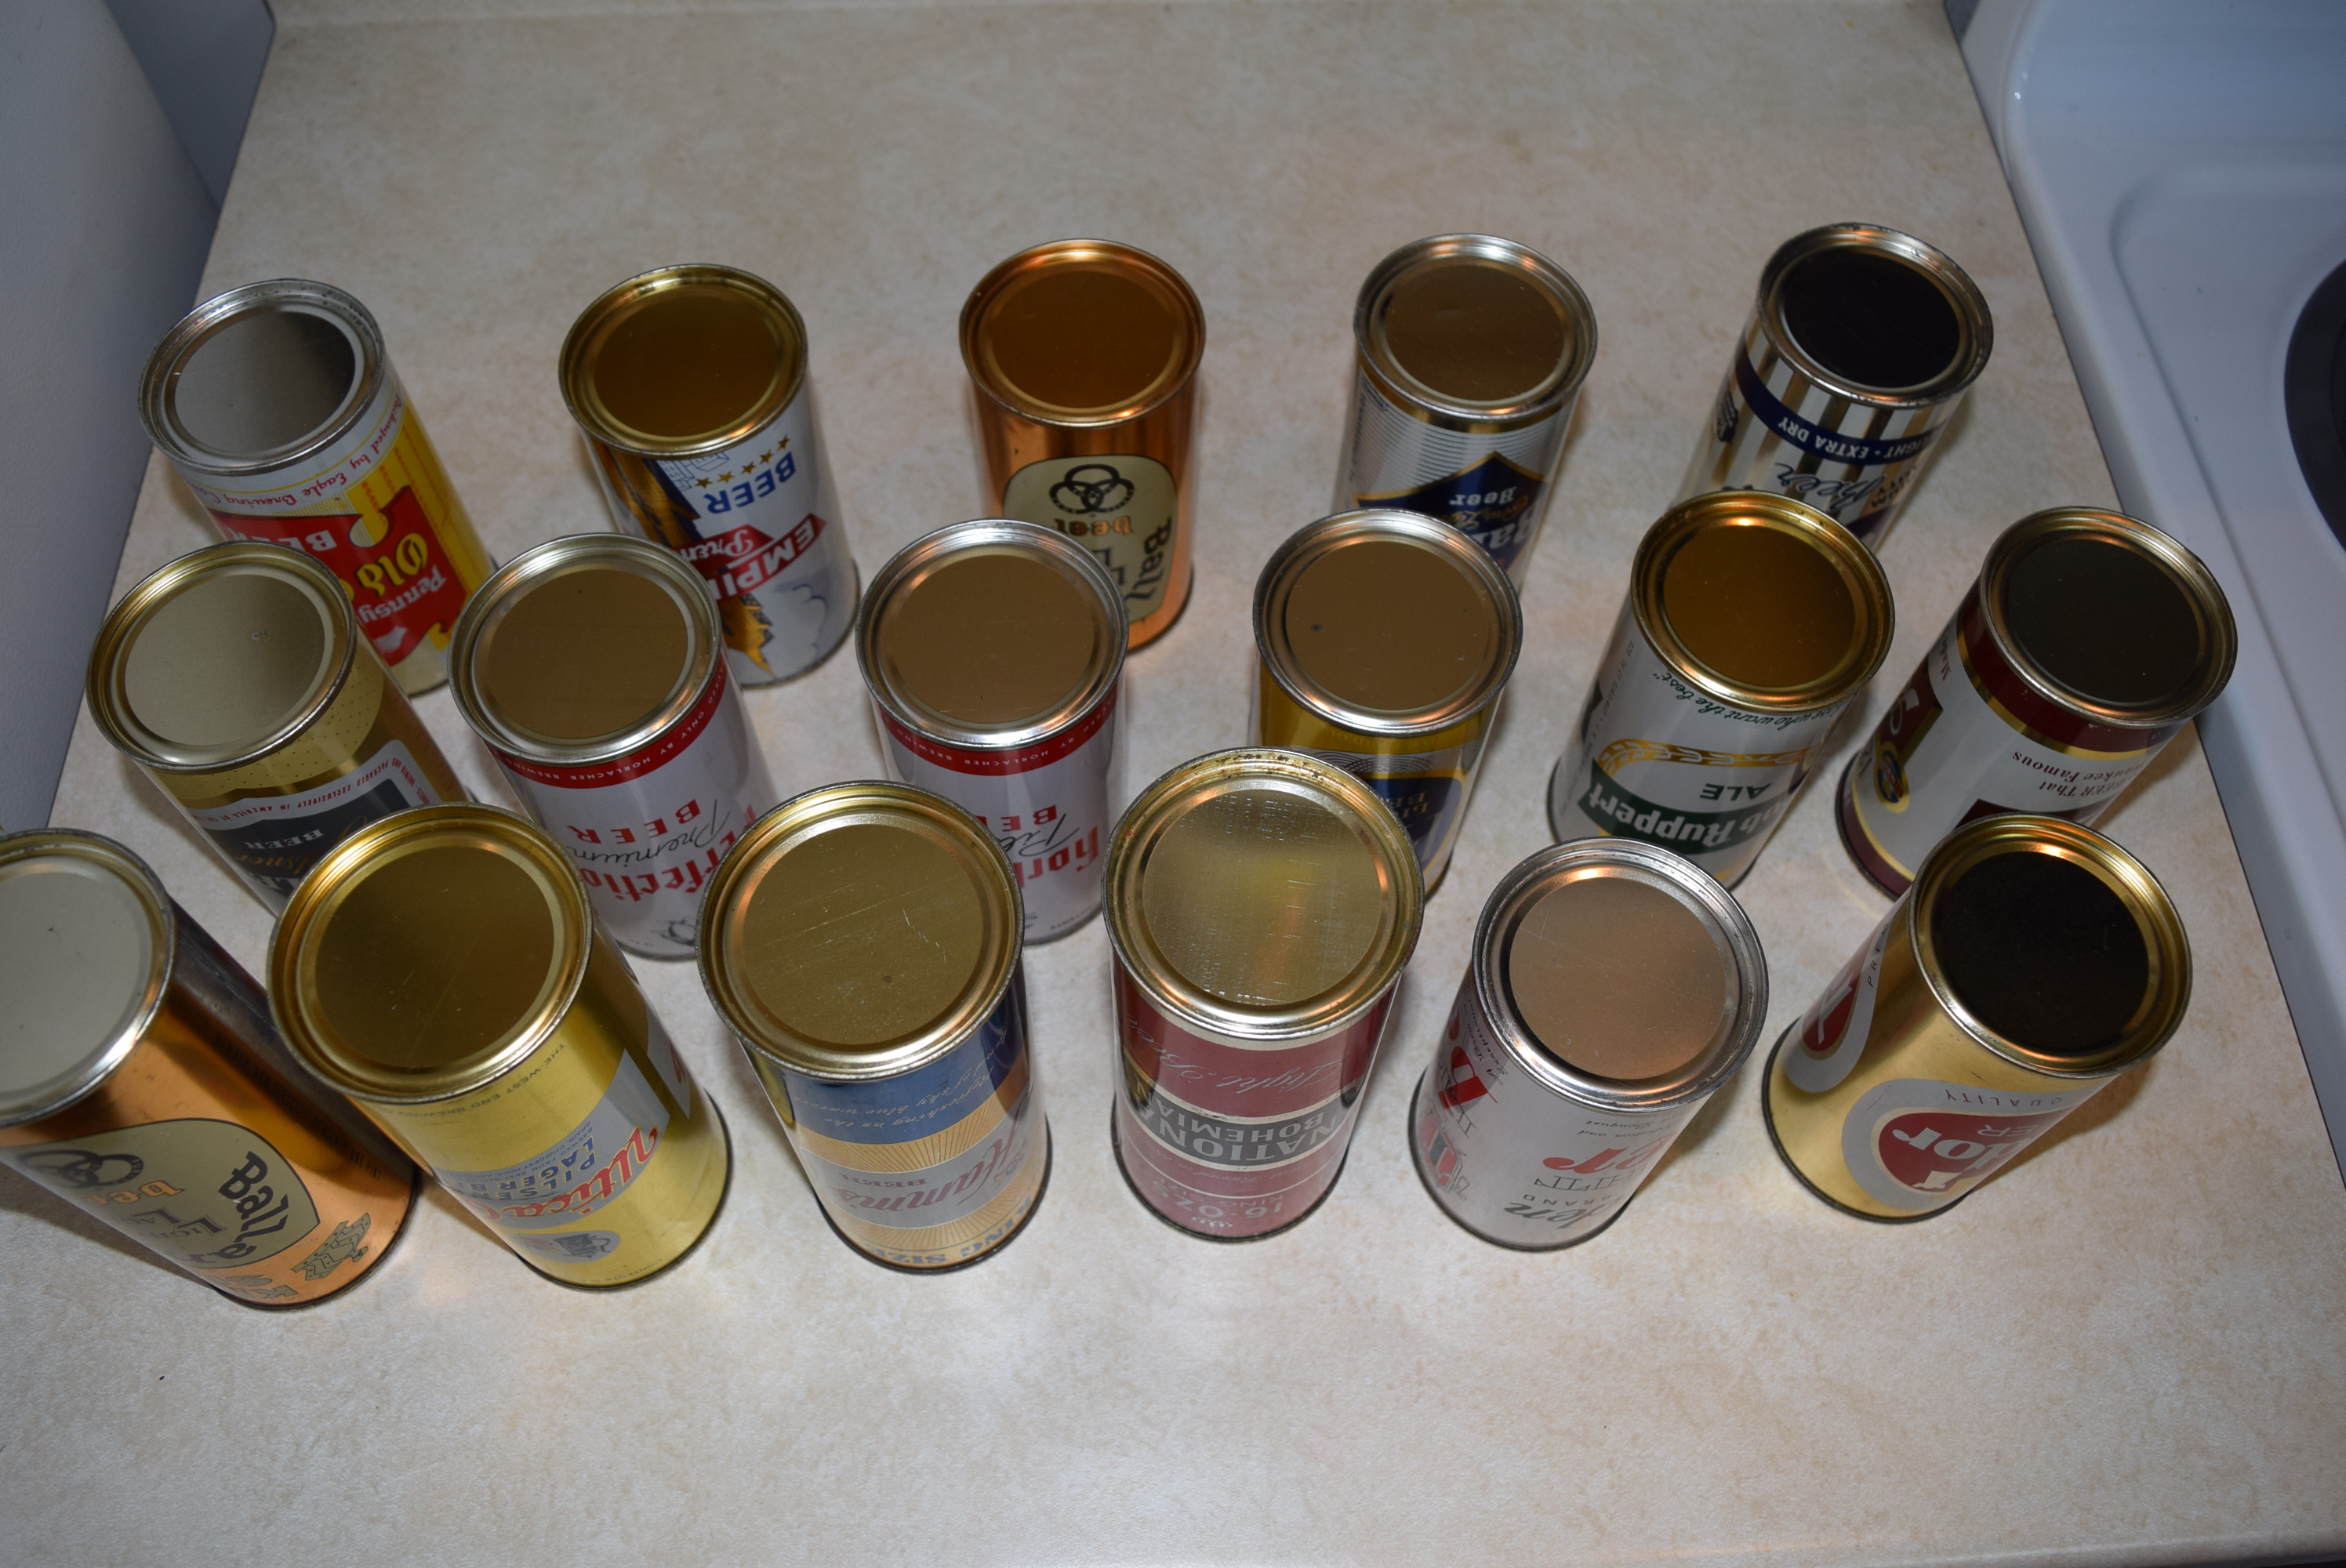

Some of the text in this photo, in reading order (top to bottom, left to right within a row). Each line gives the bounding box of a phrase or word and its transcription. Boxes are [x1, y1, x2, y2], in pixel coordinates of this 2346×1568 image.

[1777, 416, 1810, 443] DRY
[1815, 435, 1869, 459] EXTRA
[350, 454, 371, 469] by
[302, 472, 347, 496] Eagle
[703, 452, 797, 514] BEER
[1774, 463, 1886, 511] Beer
[223, 493, 298, 509] Brewing
[1448, 487, 1516, 507] Beer
[355, 532, 428, 597] Old
[356, 566, 446, 625] Pennsy
[1694, 697, 1727, 718] the
[1724, 710, 1774, 726] want
[679, 711, 708, 739] ONLY
[1774, 714, 1812, 731] who
[656, 739, 674, 755] BY
[896, 728, 952, 761] BREWING
[1060, 737, 1074, 748] BY
[505, 757, 561, 779] BREWING
[570, 757, 651, 781] HORLACHER
[964, 750, 1048, 767] HORLACHER
[2011, 751, 2080, 783] Famous
[356, 760, 389, 786] PACKAGED
[297, 783, 351, 808] EXCLUSIVELY
[1699, 782, 1773, 802] ALE
[2039, 781, 2077, 798] That
[231, 805, 273, 818] AMERICA
[566, 798, 702, 844] BEER
[1588, 783, 1739, 848] Ruppert
[242, 828, 324, 849] BEER
[565, 799, 731, 867] Premium
[996, 813, 1080, 858] Pil
[543, 1044, 565, 1065] THE
[506, 1068, 542, 1094] WEST
[470, 1093, 501, 1109] END
[915, 1087, 951, 1107] sky
[1945, 1089, 2063, 1107] QUALITY
[865, 1104, 910, 1116] blue
[823, 1117, 854, 1127] the
[1585, 1120, 1654, 1130] Bouquet
[1977, 1124, 2039, 1138] ER
[560, 1126, 593, 1156] BREWED
[499, 1136, 595, 1192] LAGER
[524, 1145, 565, 1169] CHOICEST
[532, 1157, 557, 1172] FROM
[501, 1124, 659, 1219] Utica
[504, 1171, 527, 1180] BEST
[837, 1173, 929, 1189] BEER
[76, 1179, 184, 1205] bee
[1219, 1195, 1284, 1207] KING
[1523, 1192, 1612, 1207] BRAND
[863, 1243, 946, 1265] SIZE
